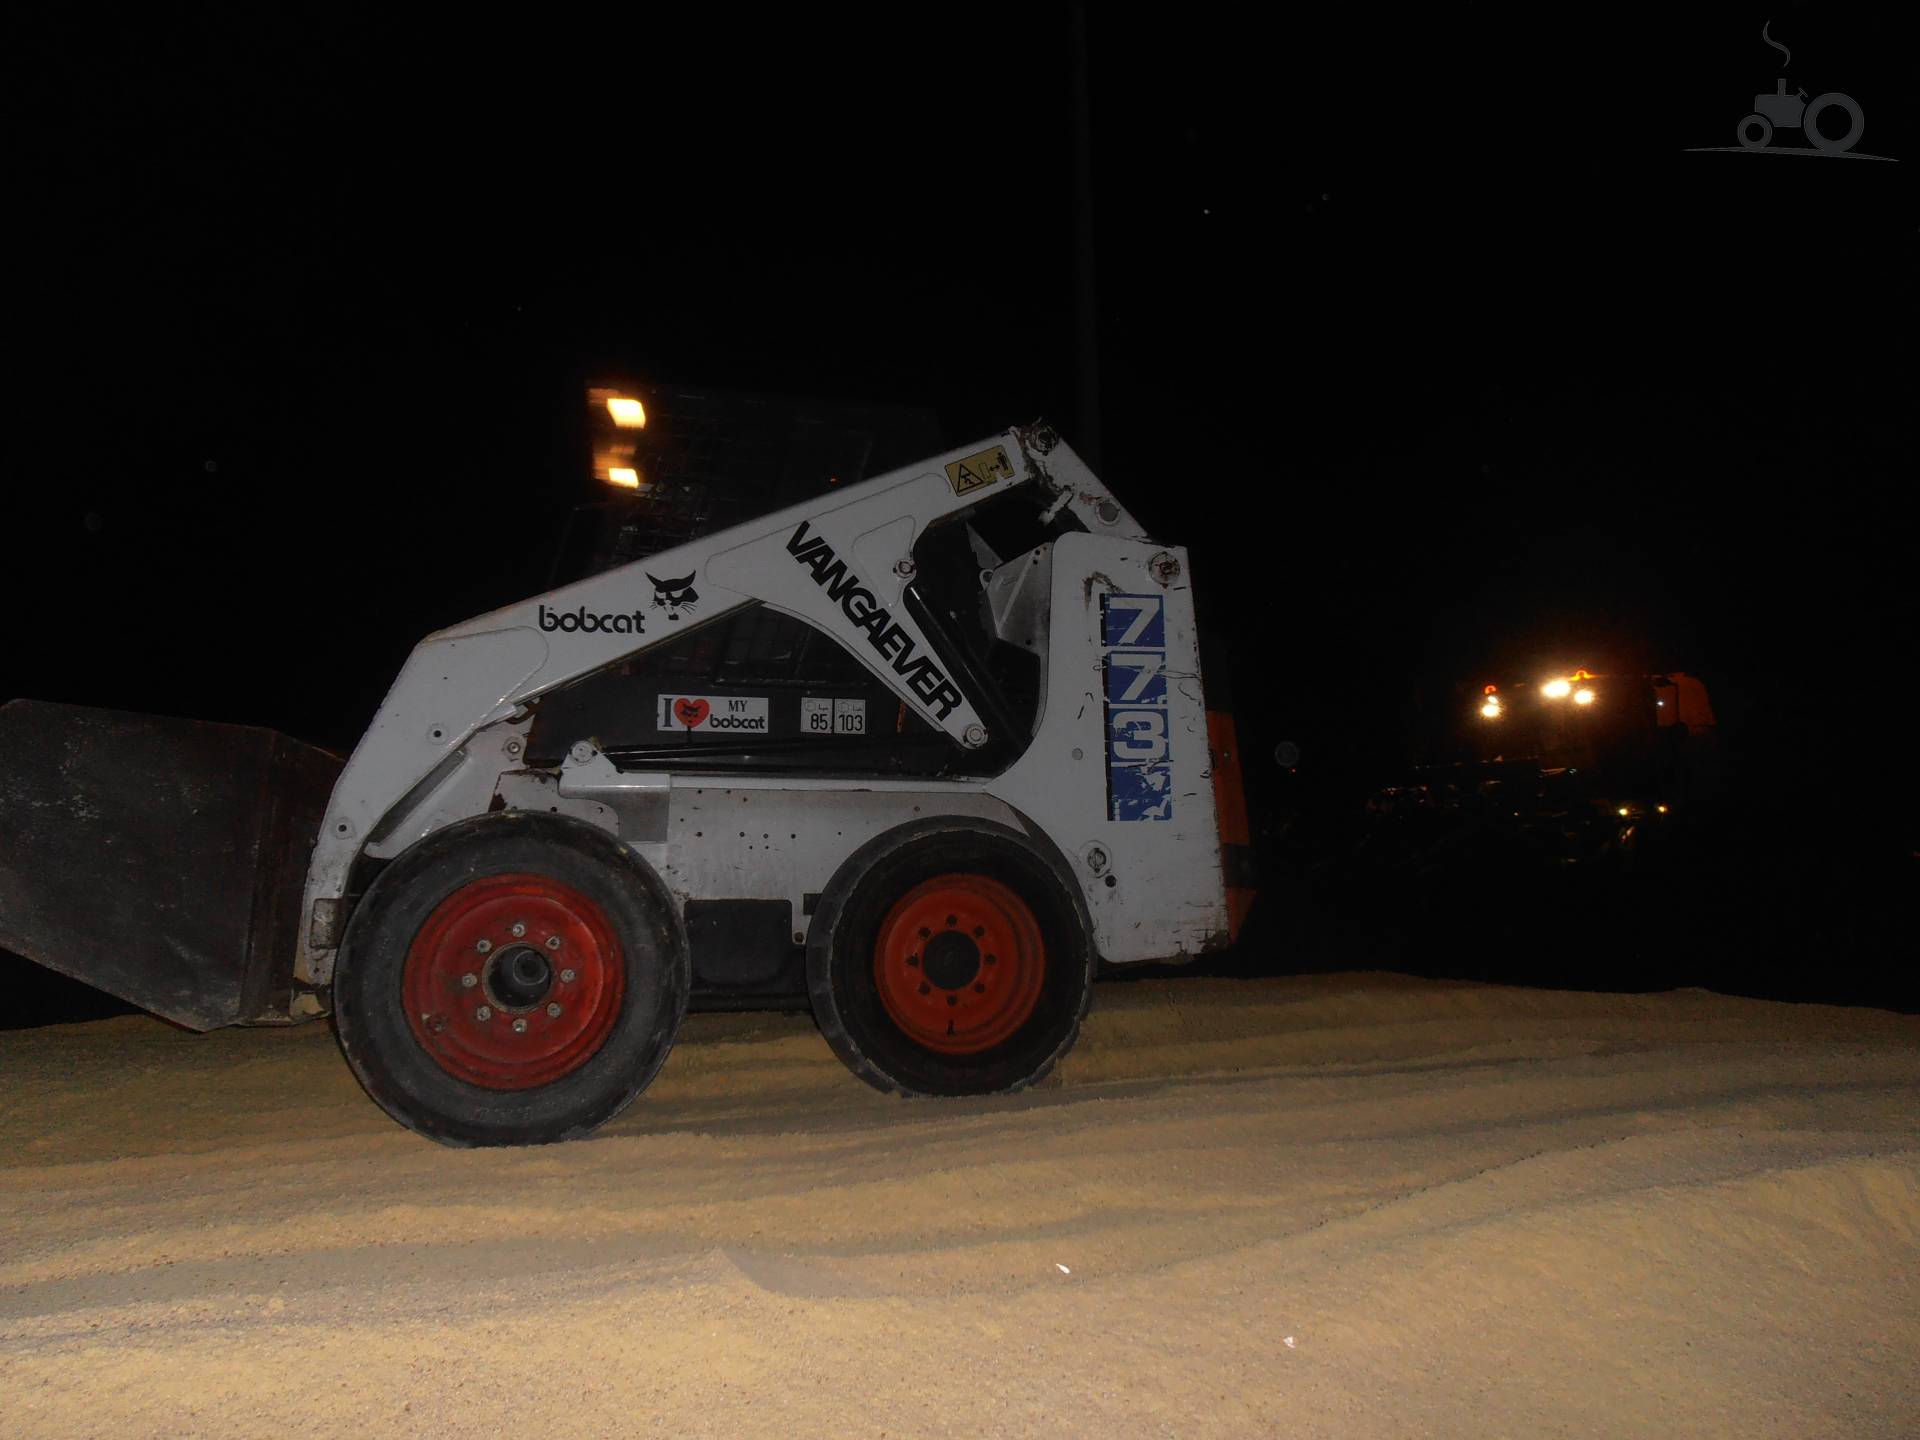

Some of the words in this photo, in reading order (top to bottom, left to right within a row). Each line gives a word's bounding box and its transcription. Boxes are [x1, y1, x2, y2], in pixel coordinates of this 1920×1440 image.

[539, 604, 645, 634] bobcat
[786, 520, 963, 722] VANGAEVER
[1108, 596, 1169, 761] 773
[663, 698, 673, 728] I
[728, 700, 747, 712] MY
[709, 714, 765, 730] bobcat
[810, 713, 828, 730] 85
[838, 714, 863, 732] 103
